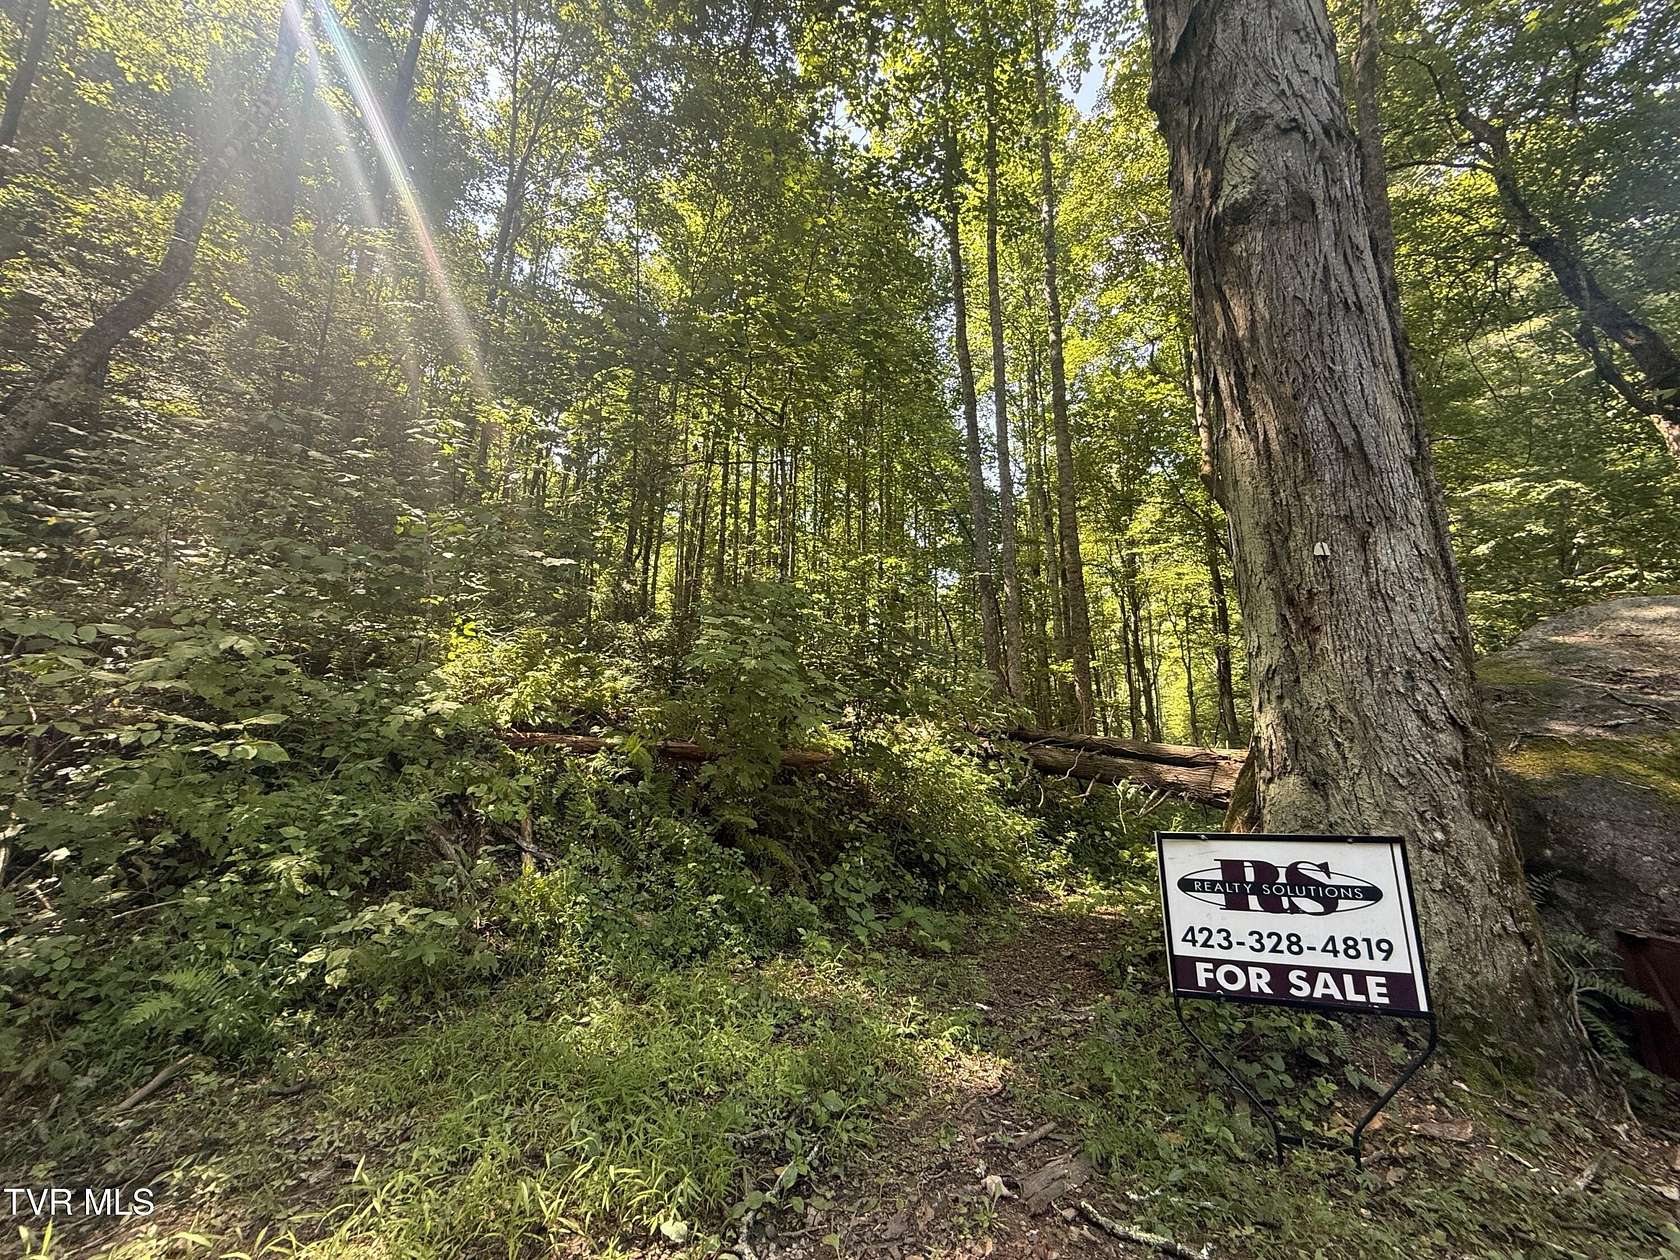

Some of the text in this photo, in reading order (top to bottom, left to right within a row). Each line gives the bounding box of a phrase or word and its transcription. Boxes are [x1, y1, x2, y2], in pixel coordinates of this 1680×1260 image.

[1194, 881, 1364, 899] REALTY SOLUTIONS
[1181, 926, 1394, 961] 423-328-4819
[1196, 962, 1390, 1004] FOR SALE
